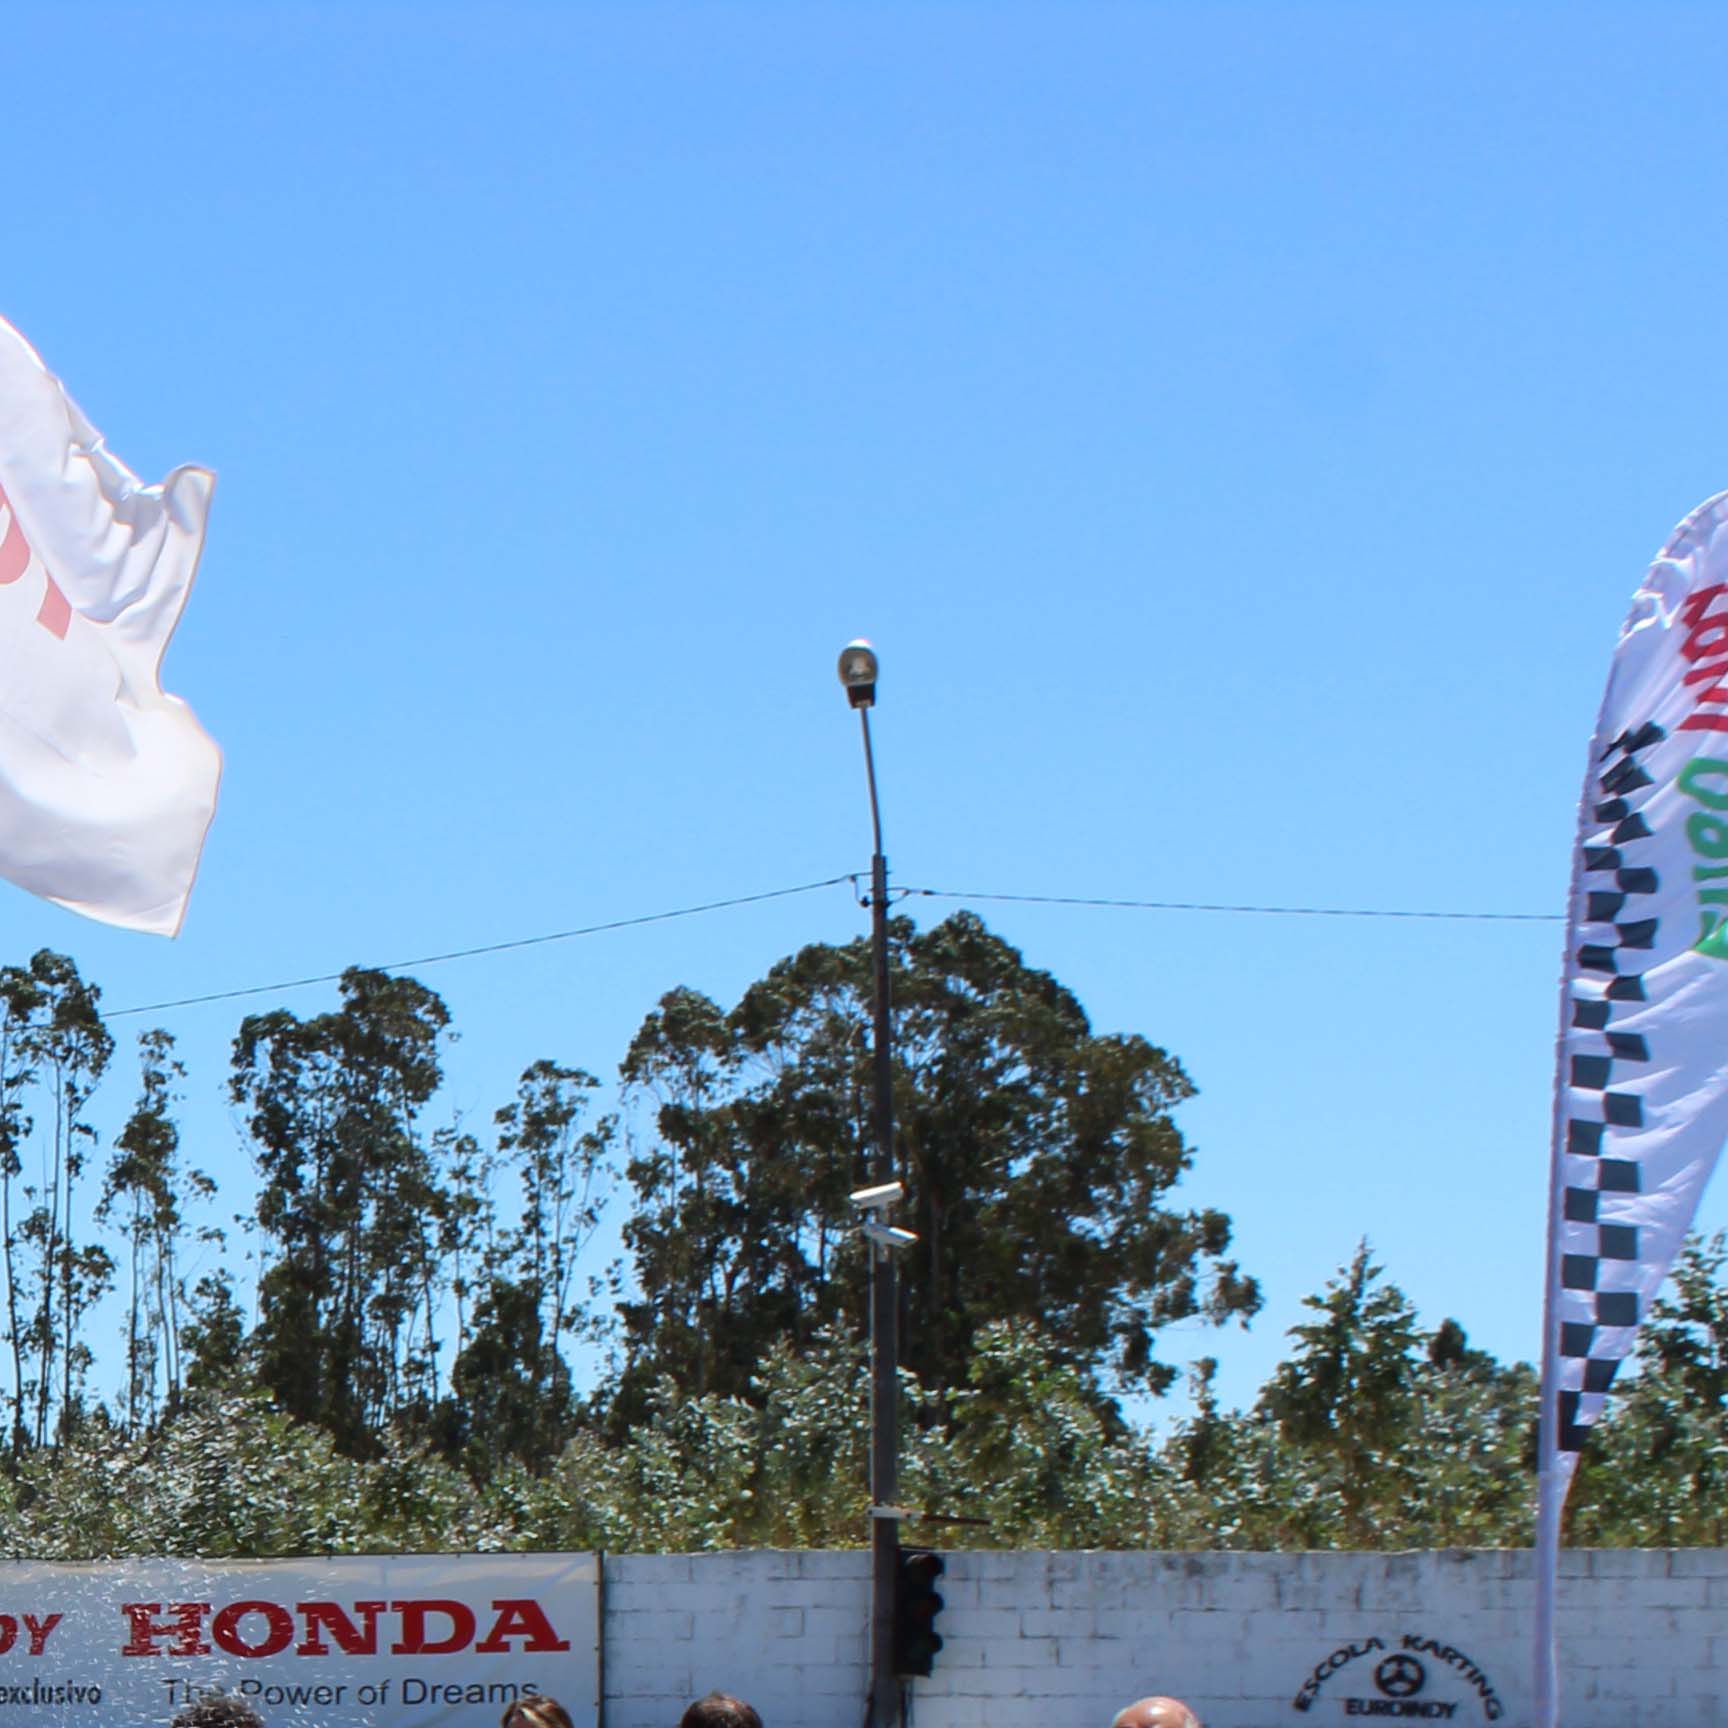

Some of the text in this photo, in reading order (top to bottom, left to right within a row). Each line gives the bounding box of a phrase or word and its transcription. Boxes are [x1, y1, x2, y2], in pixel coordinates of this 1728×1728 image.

[121, 1600, 571, 1657] HONDA
[241, 1679, 347, 1706] Power
[357, 1679, 391, 1705] of
[402, 1679, 538, 1704] Dreams
[1293, 1635, 1504, 1721] ESCOLA KARTING
